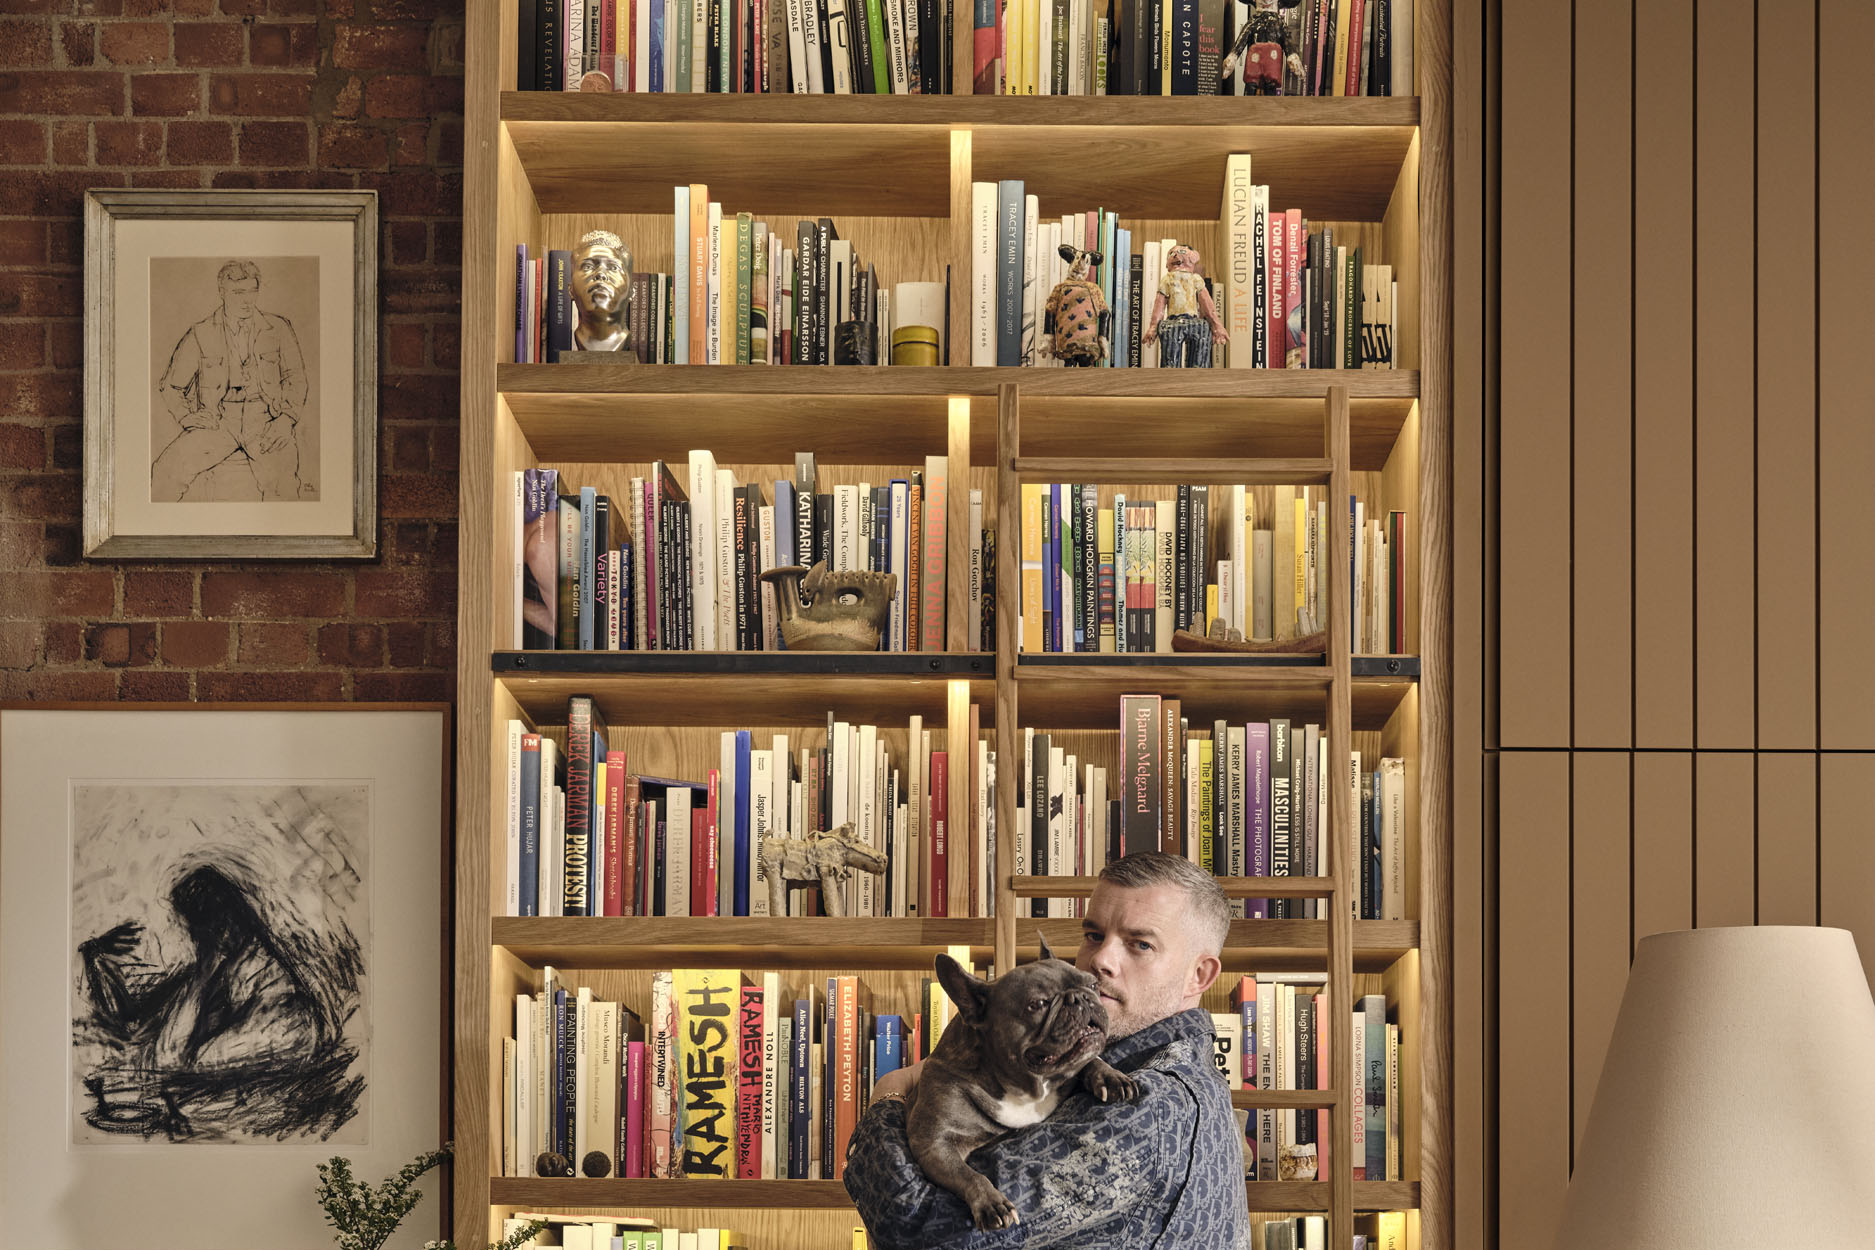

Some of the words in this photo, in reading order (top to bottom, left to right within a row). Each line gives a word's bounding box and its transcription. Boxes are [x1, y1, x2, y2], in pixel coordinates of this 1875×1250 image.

[804, 1, 816, 45] BRADLEY
[893, 28, 901, 44] AND
[1182, 21, 1191, 75] CAPOTE
[1199, 44, 1220, 53] book
[895, 46, 904, 83] MIRRORS
[1097, 54, 1107, 89] LOOKS
[1233, 169, 1247, 226] LUCIAN
[1008, 202, 1017, 238] TRACEY
[1273, 220, 1282, 246] TOM
[739, 224, 748, 272] DEGAS
[755, 232, 763, 252] Peter
[1008, 240, 1017, 264] EMIN
[1290, 223, 1298, 252] Denzil
[753, 253, 762, 270] Doig
[802, 237, 810, 277] GARDAR
[1234, 233, 1247, 284] FREUD
[1272, 249, 1282, 266] OF
[1289, 254, 1298, 295] Forrester
[802, 280, 810, 302] EIDE
[1234, 288, 1247, 298] A
[1272, 267, 1282, 319] FINLAND
[710, 306, 718, 326] Image
[711, 327, 717, 336] as
[1234, 304, 1247, 333] LIFE
[801, 305, 809, 361] EINARSSON
[912, 488, 920, 527] VINCENT
[1085, 500, 1094, 541] HOWARD
[735, 497, 746, 551] Resilience
[763, 510, 771, 541] GUSTON
[799, 491, 811, 571] KATHARINA
[859, 513, 869, 537] Gilhooly
[911, 528, 919, 546] VAN
[926, 476, 945, 575] GRIBBON
[971, 548, 980, 565] Ron
[1165, 532, 1173, 556] DAVID
[737, 553, 746, 577] Philip
[911, 548, 919, 577] GOGH
[1085, 544, 1094, 588] HODGKIN
[1164, 558, 1172, 597] HOCKNEY
[1296, 554, 1304, 573] Susan
[595, 553, 608, 604] Variety
[738, 577, 746, 603] Guston
[911, 578, 918, 589] IN
[971, 567, 980, 602] Gorchov
[1296, 575, 1304, 595] Hiller
[738, 604, 746, 613] in
[910, 591, 918, 611] FULL
[1086, 590, 1095, 639] PAINTINGS
[1164, 599, 1172, 609] BY
[568, 713, 591, 764] DEREK
[1135, 708, 1152, 750] Bjarne
[1276, 724, 1285, 762] barbican
[1231, 744, 1240, 771] KERRY
[567, 766, 590, 828] JARMAN
[1036, 775, 1044, 789] LEE
[1134, 752, 1151, 813] Melgaard
[1231, 772, 1240, 800] JAMES
[525, 806, 534, 828] PETER
[1036, 790, 1044, 818] LOZANO
[936, 820, 944, 839] ROBERT
[1231, 802, 1240, 847] MARSHALL
[1274, 777, 1289, 877] MASCULINITIES
[525, 831, 534, 854] HUJAR
[564, 833, 588, 908] PROTEST!
[1230, 849, 1240, 877] Mastry
[843, 986, 852, 1052] ELIZABETH
[1262, 995, 1271, 1013] JIM
[798, 1025, 806, 1043] Neel,
[1262, 1016, 1270, 1047] SHAW
[1299, 1009, 1309, 1032] Hugh
[566, 1013, 576, 1064] PAINTING
[740, 990, 764, 1087] RAMESH
[766, 1032, 774, 1061] NOLL
[1300, 1033, 1309, 1061] Steers
[1354, 1026, 1362, 1051] LORNA
[657, 1031, 666, 1088] INTERTWINED
[798, 1043, 806, 1068] Uptown
[1354, 1052, 1362, 1086] SIMPSON
[566, 1069, 576, 1113] PEOPLE
[682, 986, 733, 1176] RAMESH
[843, 1054, 852, 1102] PEYTON
[752, 1094, 763, 1134] MARIO
[765, 1067, 773, 1134] ALEXANDRE
[1353, 1087, 1363, 1144] COLLAGES
